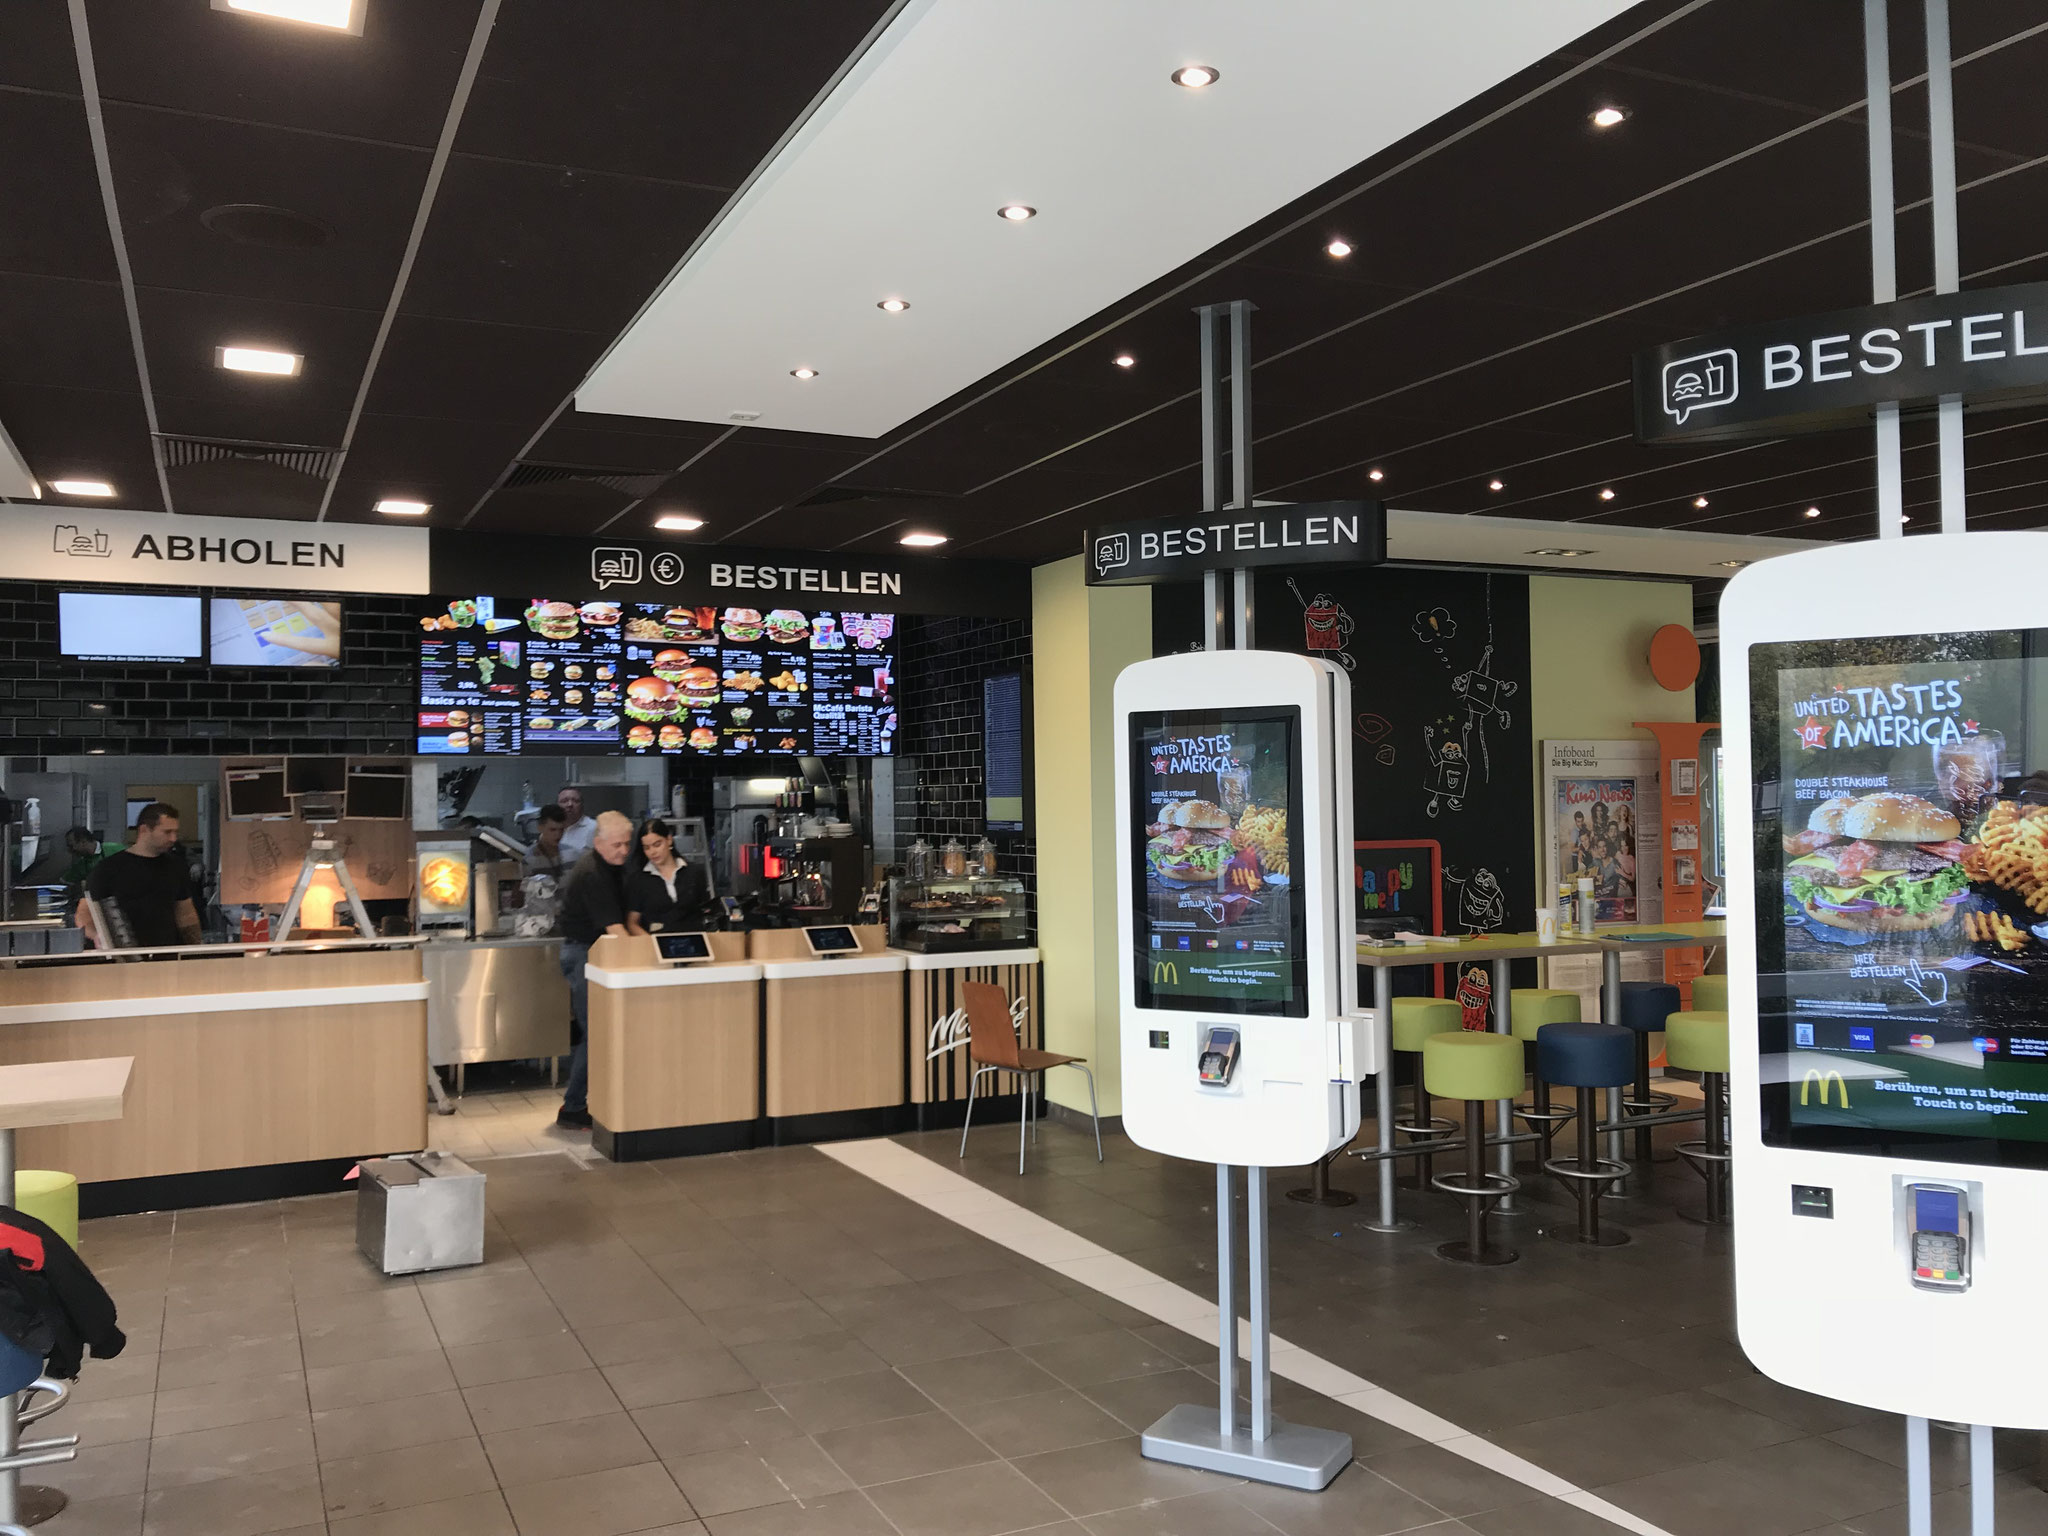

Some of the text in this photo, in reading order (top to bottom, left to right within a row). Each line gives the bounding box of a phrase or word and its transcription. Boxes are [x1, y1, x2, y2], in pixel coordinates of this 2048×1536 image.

[1764, 309, 2048, 391] BESTEL
[1140, 516, 1359, 560] BESTELLEN
[131, 533, 345, 569] ABHOLEN
[710, 563, 902, 596] BESTELLEN
[421, 696, 455, 706] Basics
[1846, 680, 1963, 719] TASTES
[813, 704, 874, 713] McCafé Barista
[813, 712, 846, 721] Qualität
[1804, 726, 1823, 743] OF
[1176, 734, 1232, 757] TASTES
[1553, 745, 1596, 758] Infoboard
[1156, 761, 1166, 771] OF
[1552, 759, 1598, 769] Die Big Mac Story
[1794, 775, 1890, 789] DOUBLE STEAKHOUSE
[1565, 782, 1634, 806] Kino News
[1794, 788, 1851, 800] BEEF BACON
[1189, 966, 1222, 976] Berühren,
[1849, 964, 1907, 979] BESTELLEN
[1207, 975, 1263, 986] Touch to begin...
[1853, 1034, 1872, 1042] VISA
[1874, 1079, 1942, 1096] Berühren,
[1944, 1085, 1968, 1098] um
[1969, 1087, 1988, 1099] zu
[1912, 1096, 2030, 1116] Touch to begin...
